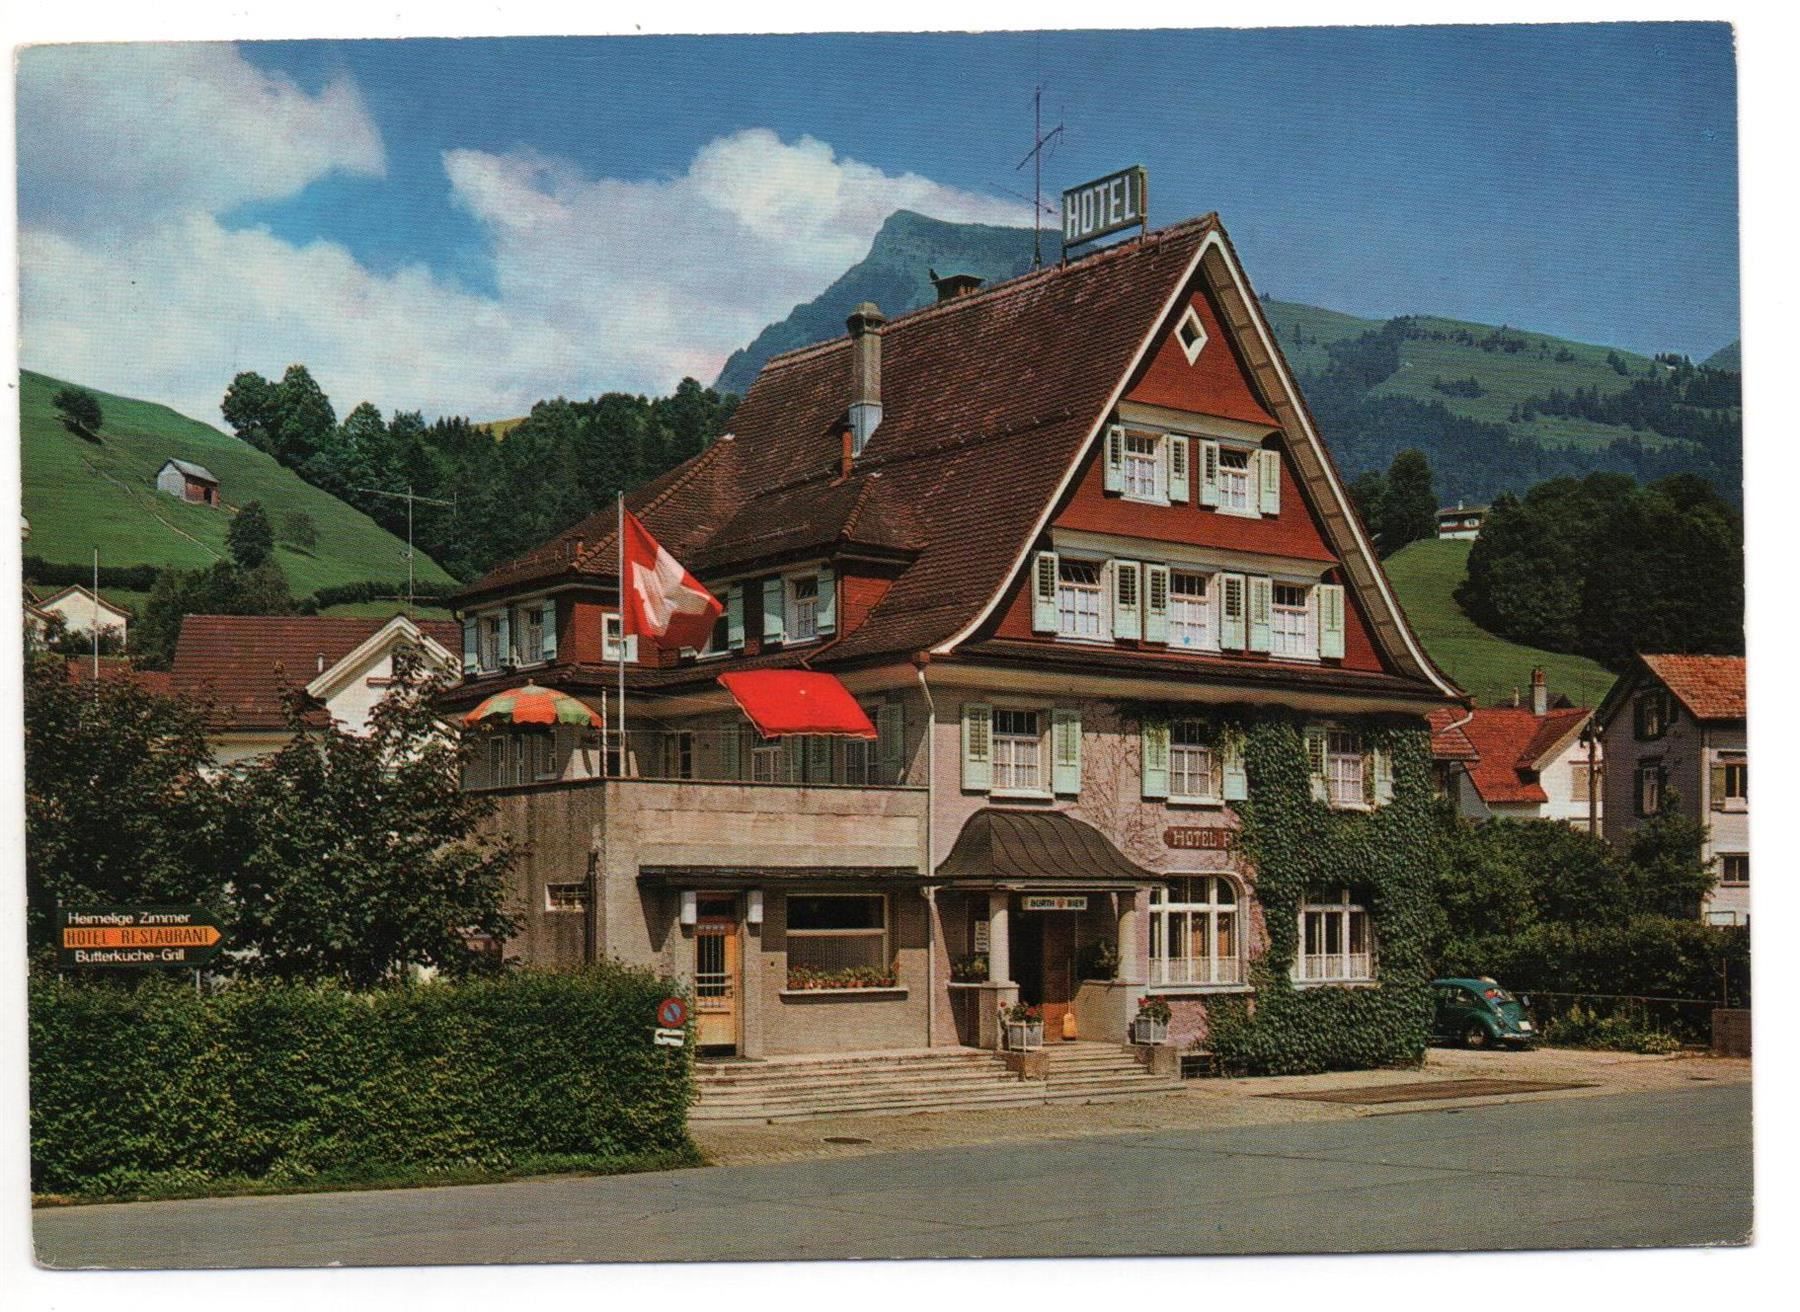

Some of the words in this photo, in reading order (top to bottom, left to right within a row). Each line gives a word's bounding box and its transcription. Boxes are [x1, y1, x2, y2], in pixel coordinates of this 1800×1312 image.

[1066, 175, 1136, 240] HOTEL
[1173, 830, 1217, 847] HOTEL
[68, 912, 133, 926] Heimelige
[139, 911, 191, 924] Zimmer
[66, 930, 106, 946] HOTEL
[121, 928, 210, 945] RESTAURANT
